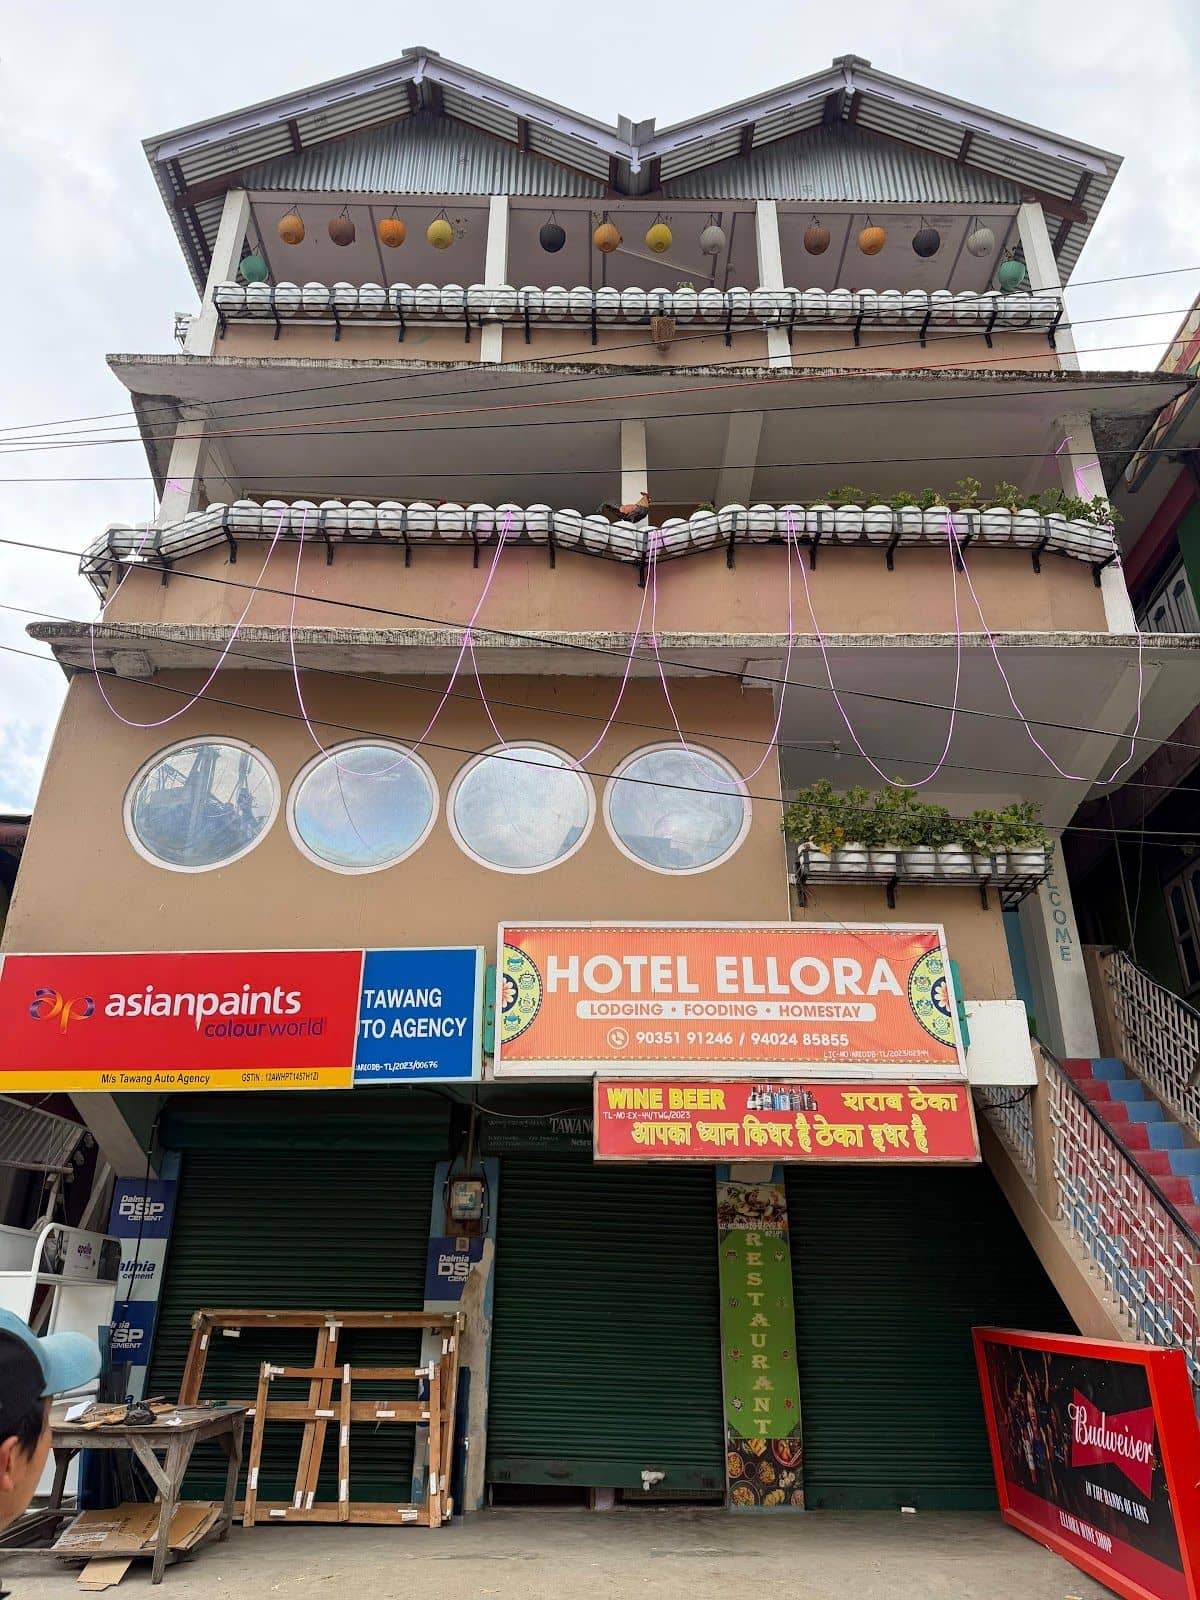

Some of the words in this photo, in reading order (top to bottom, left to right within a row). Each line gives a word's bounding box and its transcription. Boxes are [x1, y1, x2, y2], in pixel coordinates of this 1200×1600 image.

[546, 955, 700, 993] HOTEL
[715, 956, 904, 996] ELLORA
[104, 984, 302, 1031] asianpaints
[364, 989, 442, 1009] TAWANG
[589, 1003, 664, 1016] LODGING
[684, 1004, 758, 1017] FOODING
[779, 1005, 861, 1018] HOMESTAY
[357, 1019, 386, 1039] TO
[390, 1018, 467, 1038] AGENCY
[635, 1031, 680, 1045] 90351
[686, 1032, 733, 1045] 91246
[751, 1033, 798, 1046] 94024
[802, 1033, 849, 1047] 85855
[101, 1074, 117, 1084] M/s
[119, 1074, 152, 1085] Tawang
[154, 1073, 175, 1083] Auto
[177, 1073, 210, 1084] Agency
[606, 1087, 663, 1110] WINE
[668, 1088, 725, 1111] BEER
[841, 1092, 902, 1112] शराब
[907, 1086, 958, 1112] ठेका
[631, 1122, 692, 1146] आपका
[696, 1121, 740, 1147] ध्यान
[742, 1114, 793, 1148] किधर
[795, 1112, 812, 1153] है
[813, 1114, 864, 1148] ठेका
[869, 1123, 909, 1153] इधर
[911, 1113, 929, 1153] है
[119, 1203, 164, 1216] DSP
[119, 1260, 156, 1272] almia
[110, 1329, 144, 1342] SP
[746, 1232, 775, 1435] RESTAURANT
[1068, 1403, 1154, 1465] Budweiser
[1092, 1484, 1103, 1503] THE
[1103, 1489, 1124, 1513] HANDS
[1123, 1497, 1132, 1517] OF
[1131, 1501, 1149, 1525] FANS
[1094, 1530, 1112, 1554] SHOP
